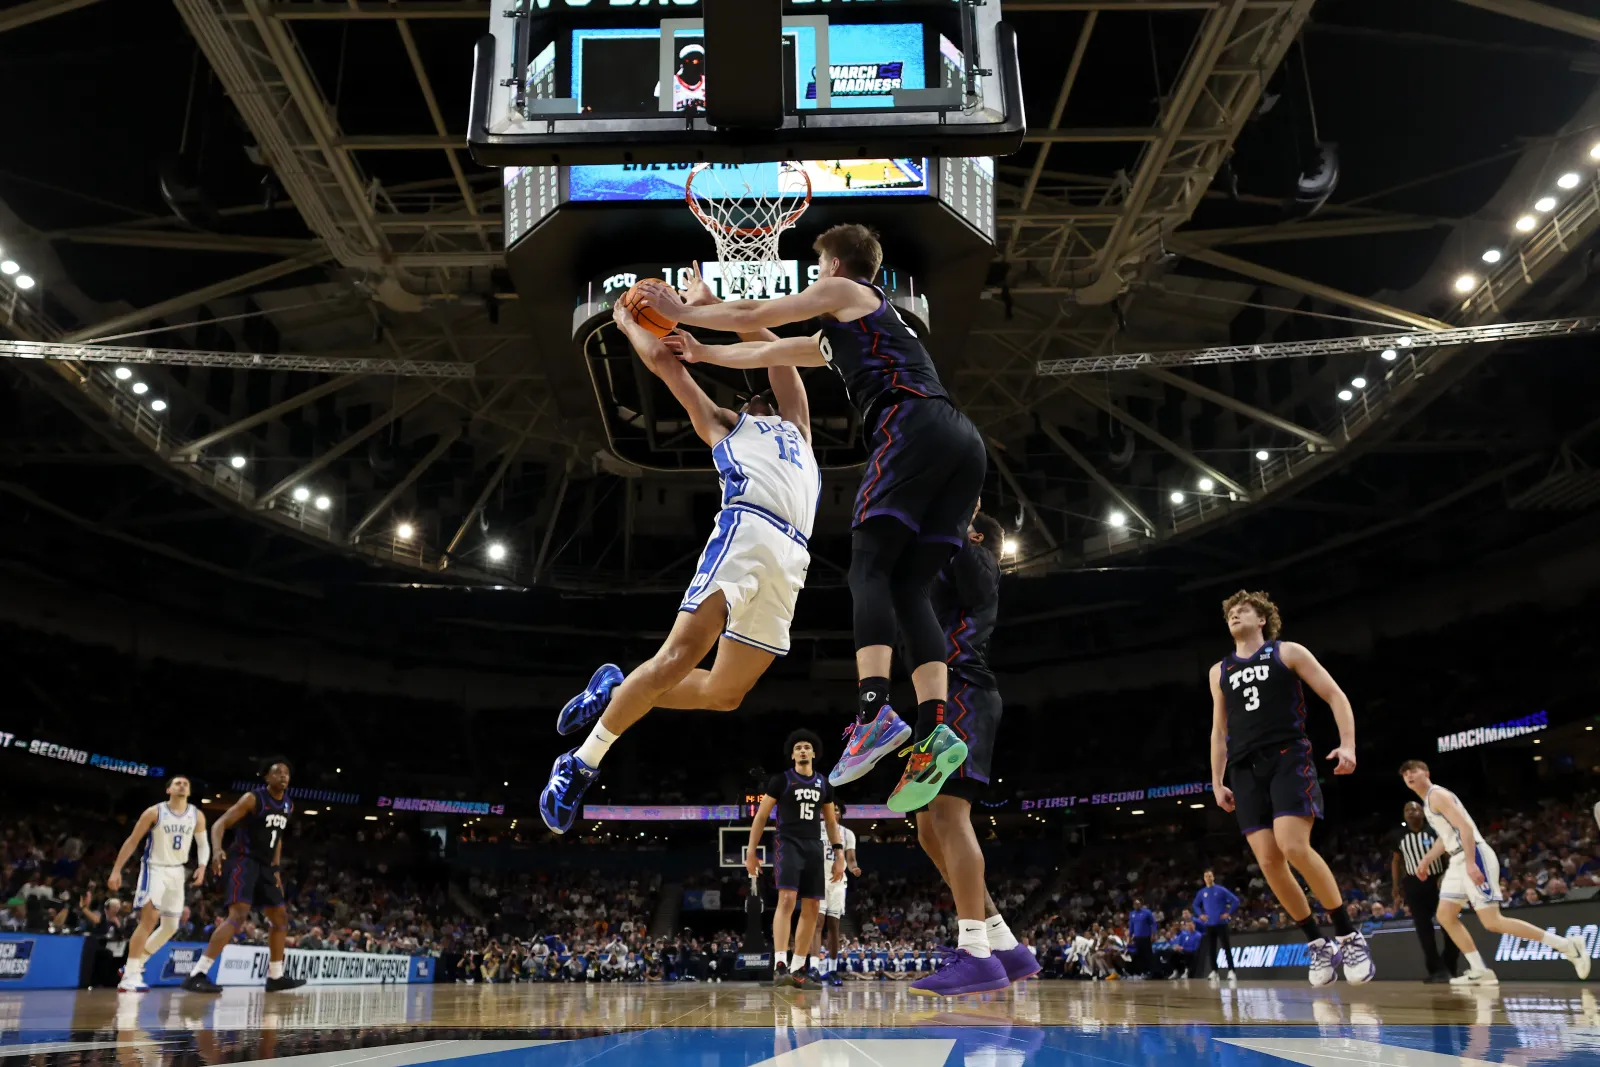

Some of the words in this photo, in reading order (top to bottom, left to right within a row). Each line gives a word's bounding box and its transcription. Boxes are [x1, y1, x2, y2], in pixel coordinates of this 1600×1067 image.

[829, 66, 878, 80] MARCH
[833, 79, 901, 92] MADNESS
[602, 273, 638, 294] TCU
[753, 421, 802, 443] DUK
[774, 436, 804, 470] 12
[1229, 665, 1270, 690] TCU
[1243, 686, 1260, 712] 3
[29, 739, 88, 765] SECOND
[89, 752, 149, 777] ROUNDS
[794, 788, 820, 802] TCU
[1037, 796, 1076, 809] FIRST
[1091, 790, 1144, 805] SECOND
[1147, 783, 1202, 799] ROUNDS
[265, 814, 287, 829] TCU
[799, 802, 815, 820] 15
[163, 824, 192, 835] DUKE
[269, 829, 277, 848] 1
[173, 835, 182, 850] 8
[1495, 925, 1600, 962] NCAA.CO
[251, 953, 299, 979] FUAN
[300, 955, 320, 979] AND
[322, 956, 364, 979] SOUTHERN
